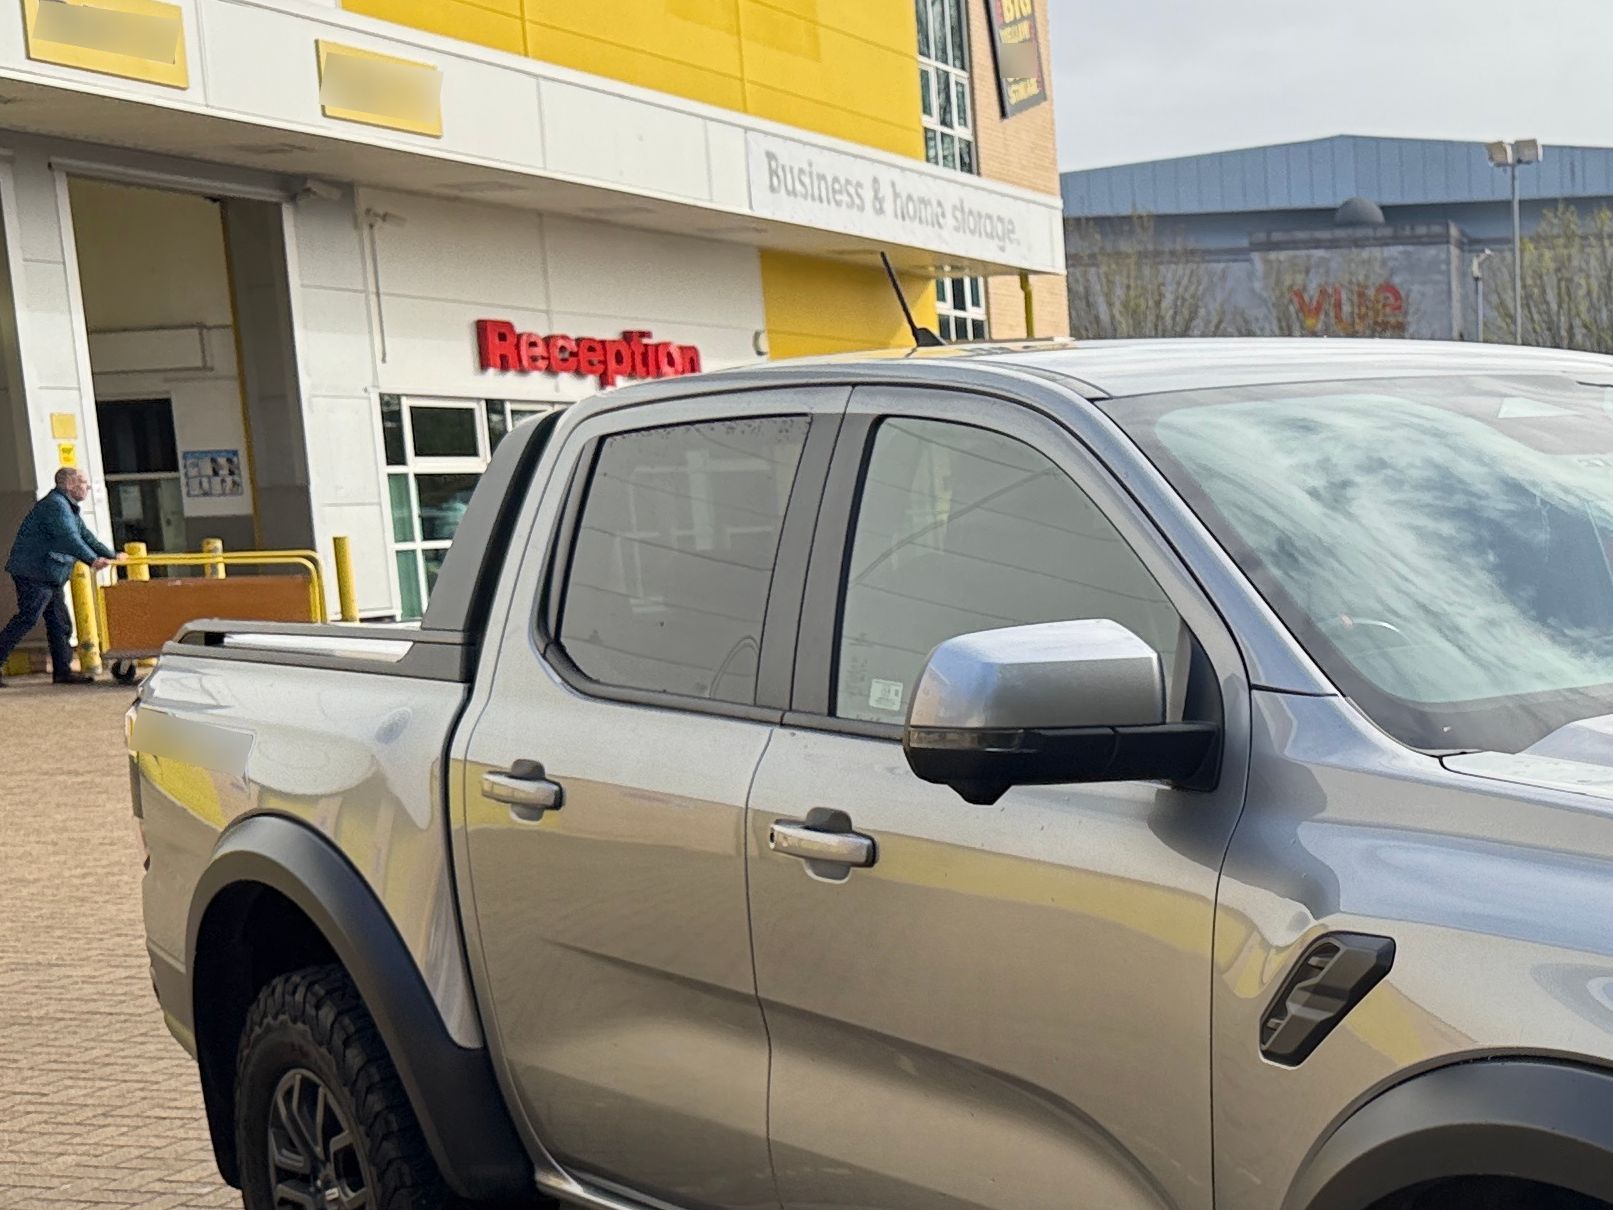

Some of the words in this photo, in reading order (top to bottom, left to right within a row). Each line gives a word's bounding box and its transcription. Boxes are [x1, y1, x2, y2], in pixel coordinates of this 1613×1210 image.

[765, 150, 866, 214] Business
[871, 176, 886, 216] &
[891, 179, 946, 230] home
[951, 200, 1021, 252] storage.
[475, 319, 701, 389] Reception
